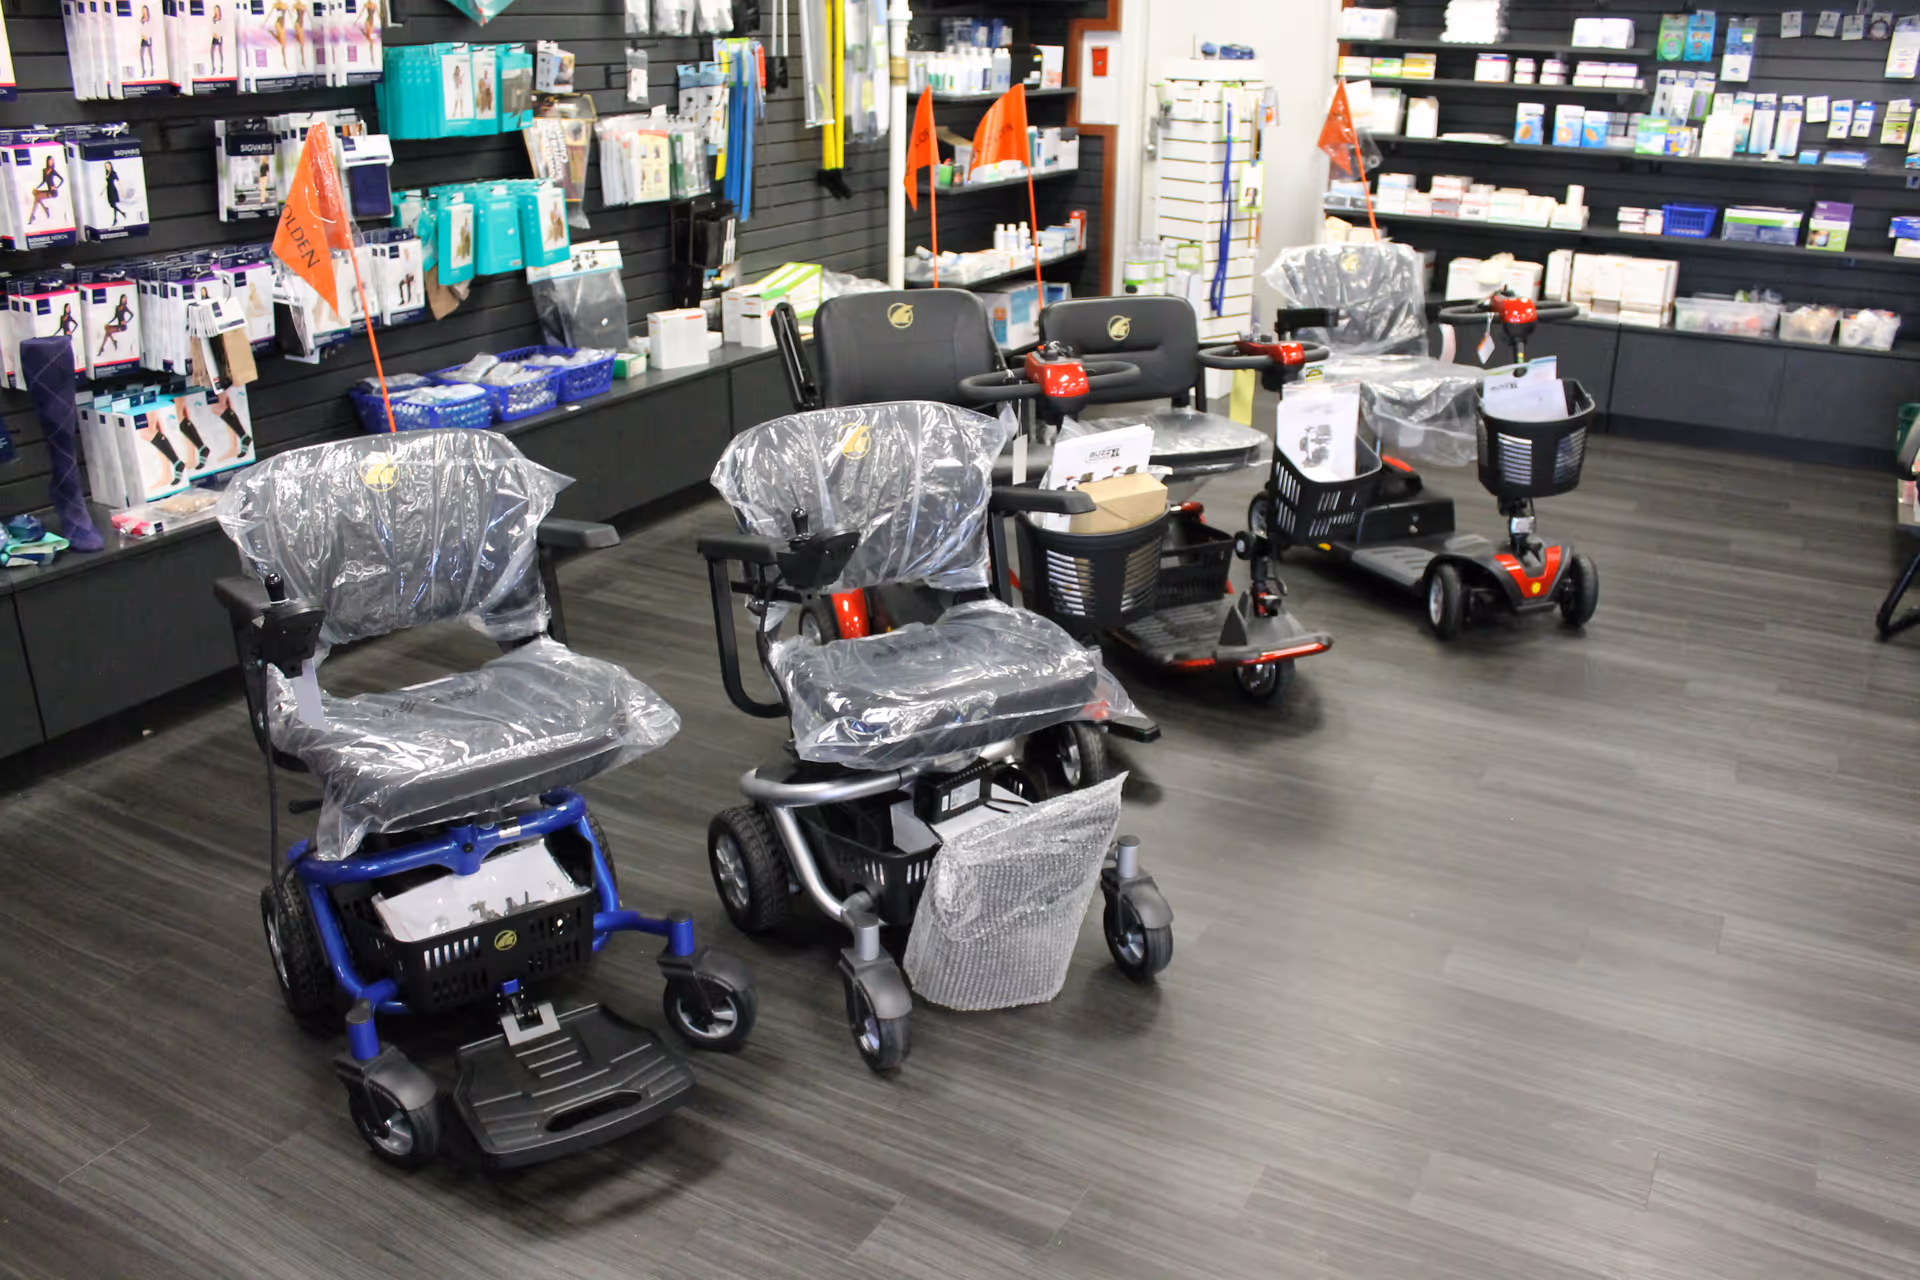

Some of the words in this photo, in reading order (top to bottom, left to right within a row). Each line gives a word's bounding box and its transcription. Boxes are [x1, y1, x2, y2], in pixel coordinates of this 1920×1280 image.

[114, 148, 140, 156] SIGVARIS
[240, 143, 272, 152] SIGVARIS
[281, 204, 320, 268] OLDEN
